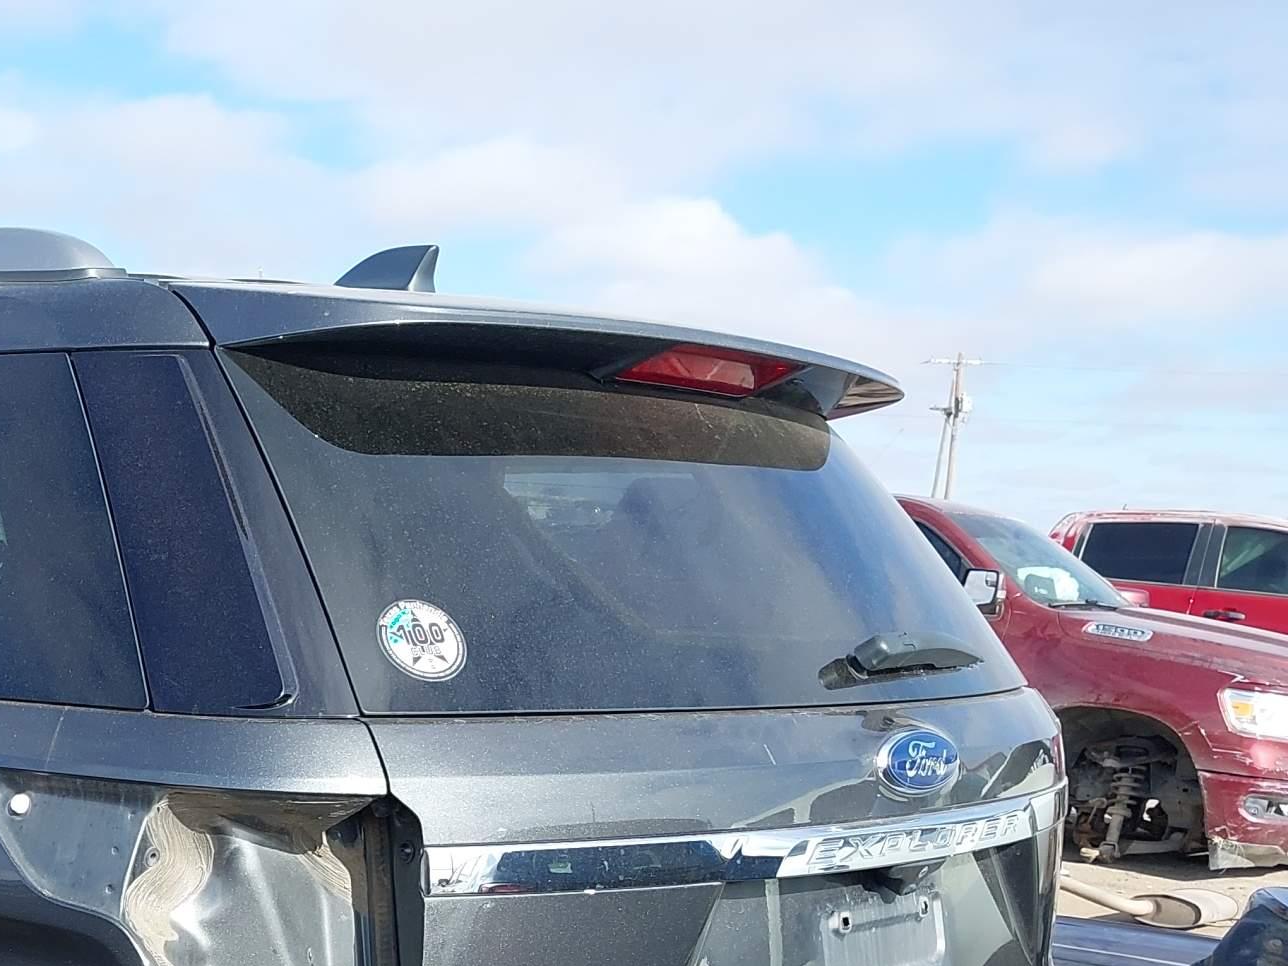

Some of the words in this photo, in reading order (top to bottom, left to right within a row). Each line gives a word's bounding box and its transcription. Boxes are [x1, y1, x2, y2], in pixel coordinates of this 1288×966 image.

[395, 622, 446, 646] 100
[905, 740, 948, 778] Ford
[808, 812, 1022, 865] EXPLORER
